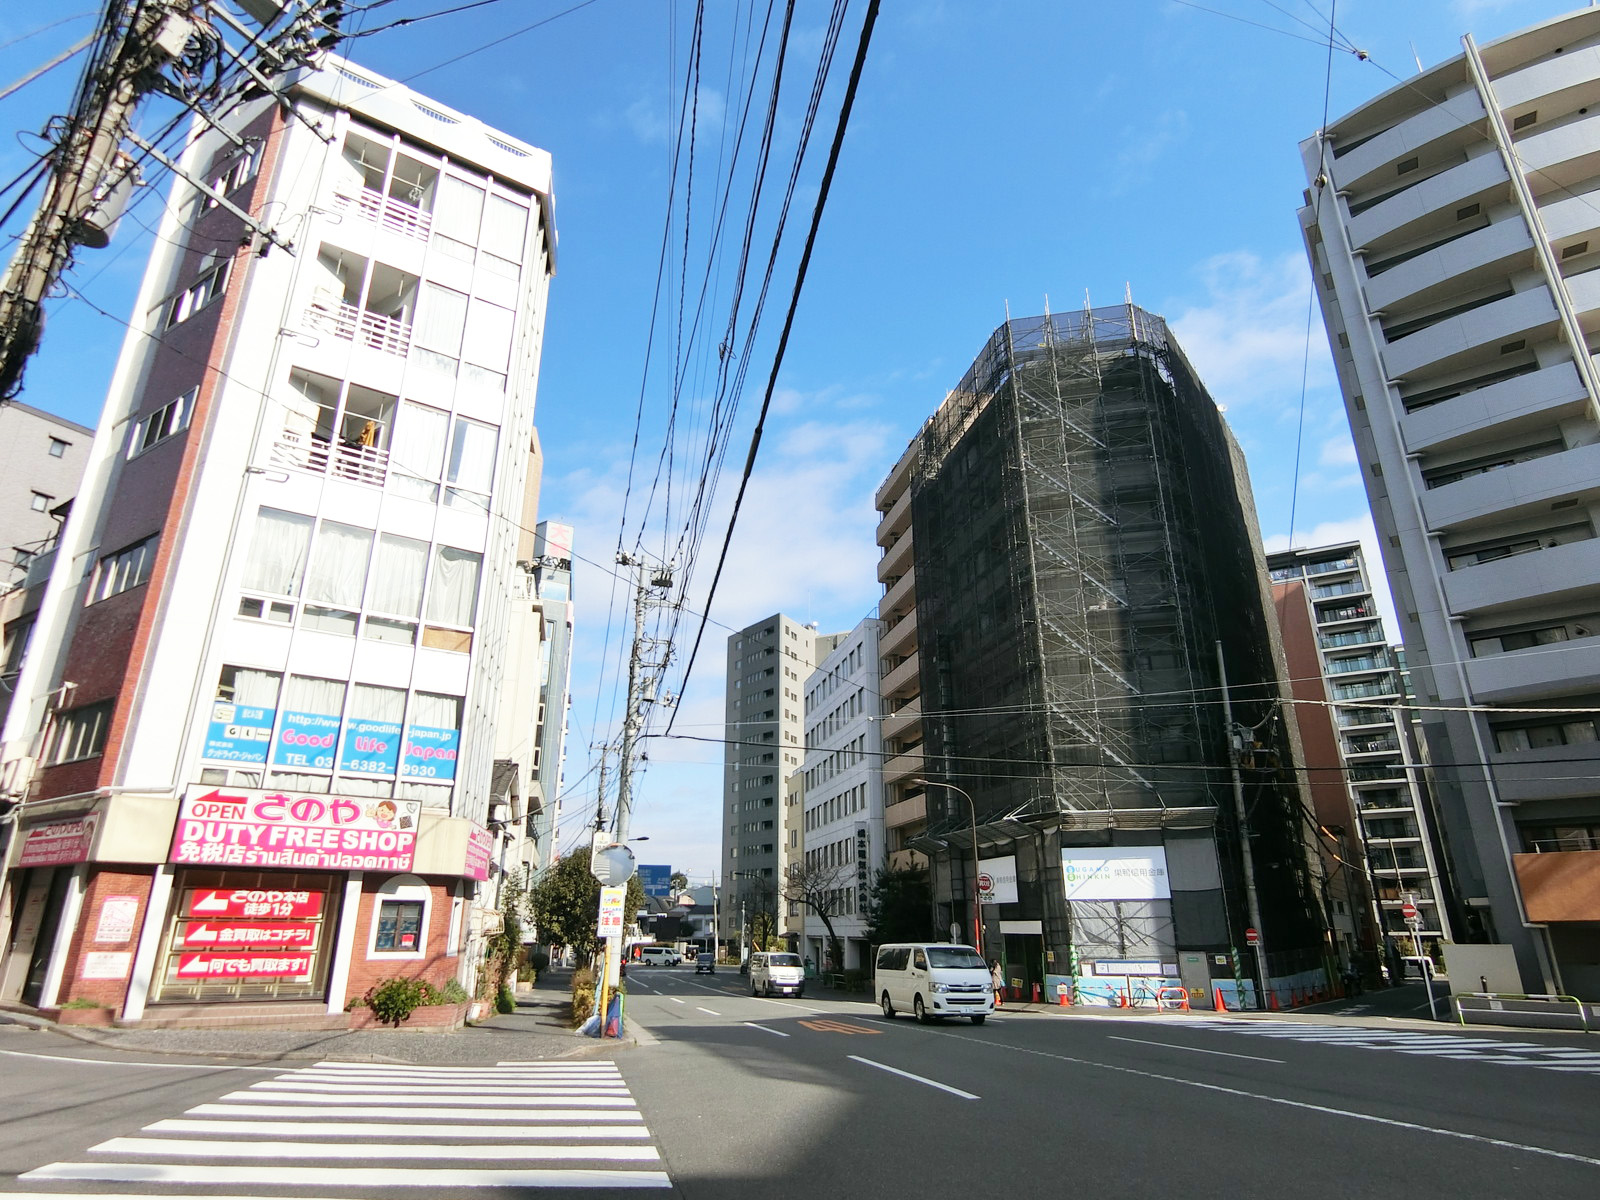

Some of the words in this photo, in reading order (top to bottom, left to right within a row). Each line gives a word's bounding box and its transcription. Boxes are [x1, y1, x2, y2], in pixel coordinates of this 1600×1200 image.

[282, 728, 334, 748] Good
[355, 735, 387, 753] Life
[405, 742, 457, 761] Japan
[286, 753, 309, 766] TEL
[314, 755, 436, 777] 03-6382-9930
[191, 803, 246, 820] OPEN
[253, 793, 361, 825] さのや
[182, 821, 266, 844] DUTY
[269, 826, 339, 849] FREE
[341, 829, 414, 852] SHOP
[176, 841, 247, 864] 免税店
[230, 890, 309, 903] さのや本店
[244, 902, 293, 916] 徒歩1分
